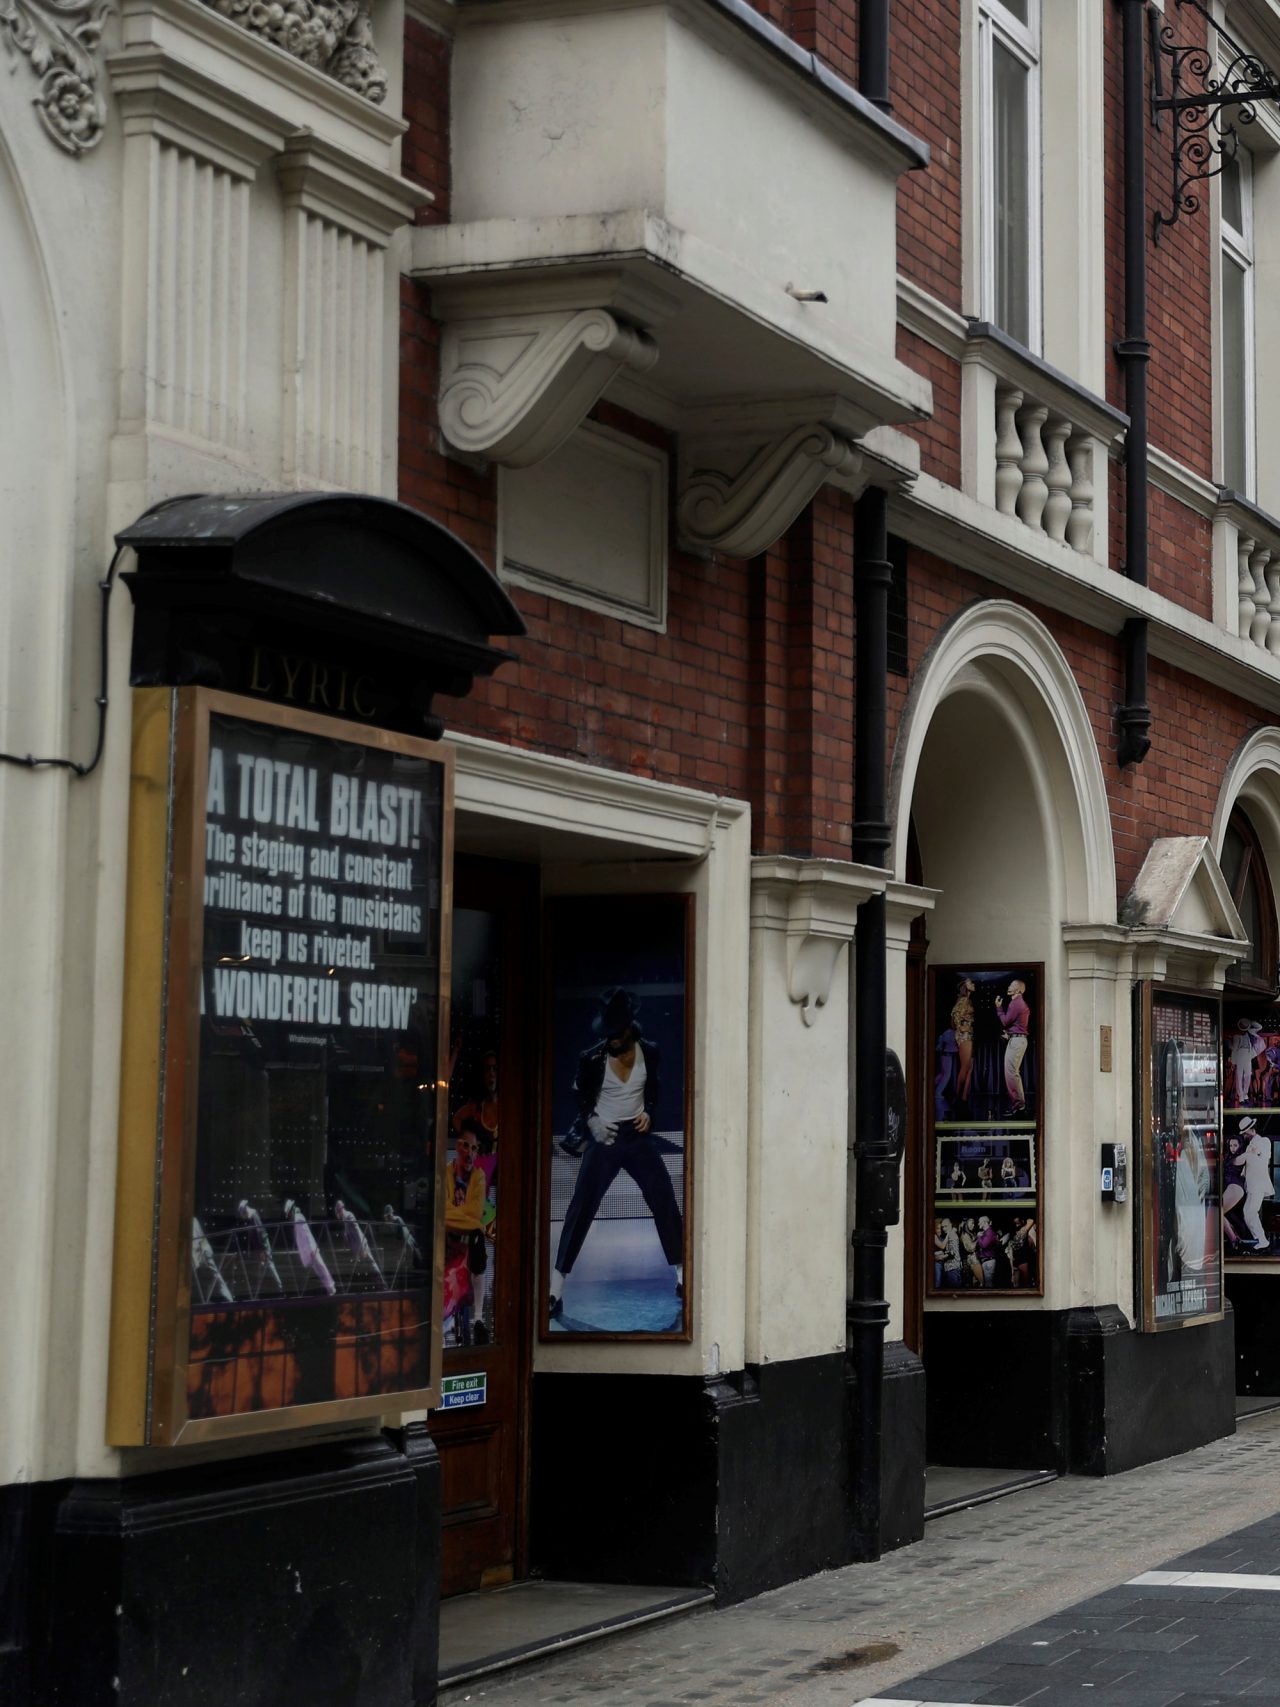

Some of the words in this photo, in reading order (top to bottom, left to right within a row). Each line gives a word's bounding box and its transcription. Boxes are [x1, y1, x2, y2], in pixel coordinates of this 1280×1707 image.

[248, 647, 376, 717] LYRIC
[206, 747, 226, 815] A
[237, 752, 320, 833] TOTAL
[330, 772, 421, 850] BLAST!
[206, 823, 236, 864] The
[241, 831, 304, 880] staging
[310, 845, 340, 880] and
[345, 853, 413, 891] constant
[288, 883, 306, 918] of
[310, 885, 336, 923] the
[341, 894, 421, 934] musicians
[240, 919, 282, 966] keep
[287, 931, 308, 963] us
[313, 930, 376, 971] riveted.
[214, 968, 342, 1025] WONDERFUL
[349, 981, 418, 1031] SHOW'
[449, 1394, 465, 1405] Keep
[465, 1392, 480, 1402] clear
[452, 1380, 465, 1390] Fire
[465, 1377, 478, 1388] exit
